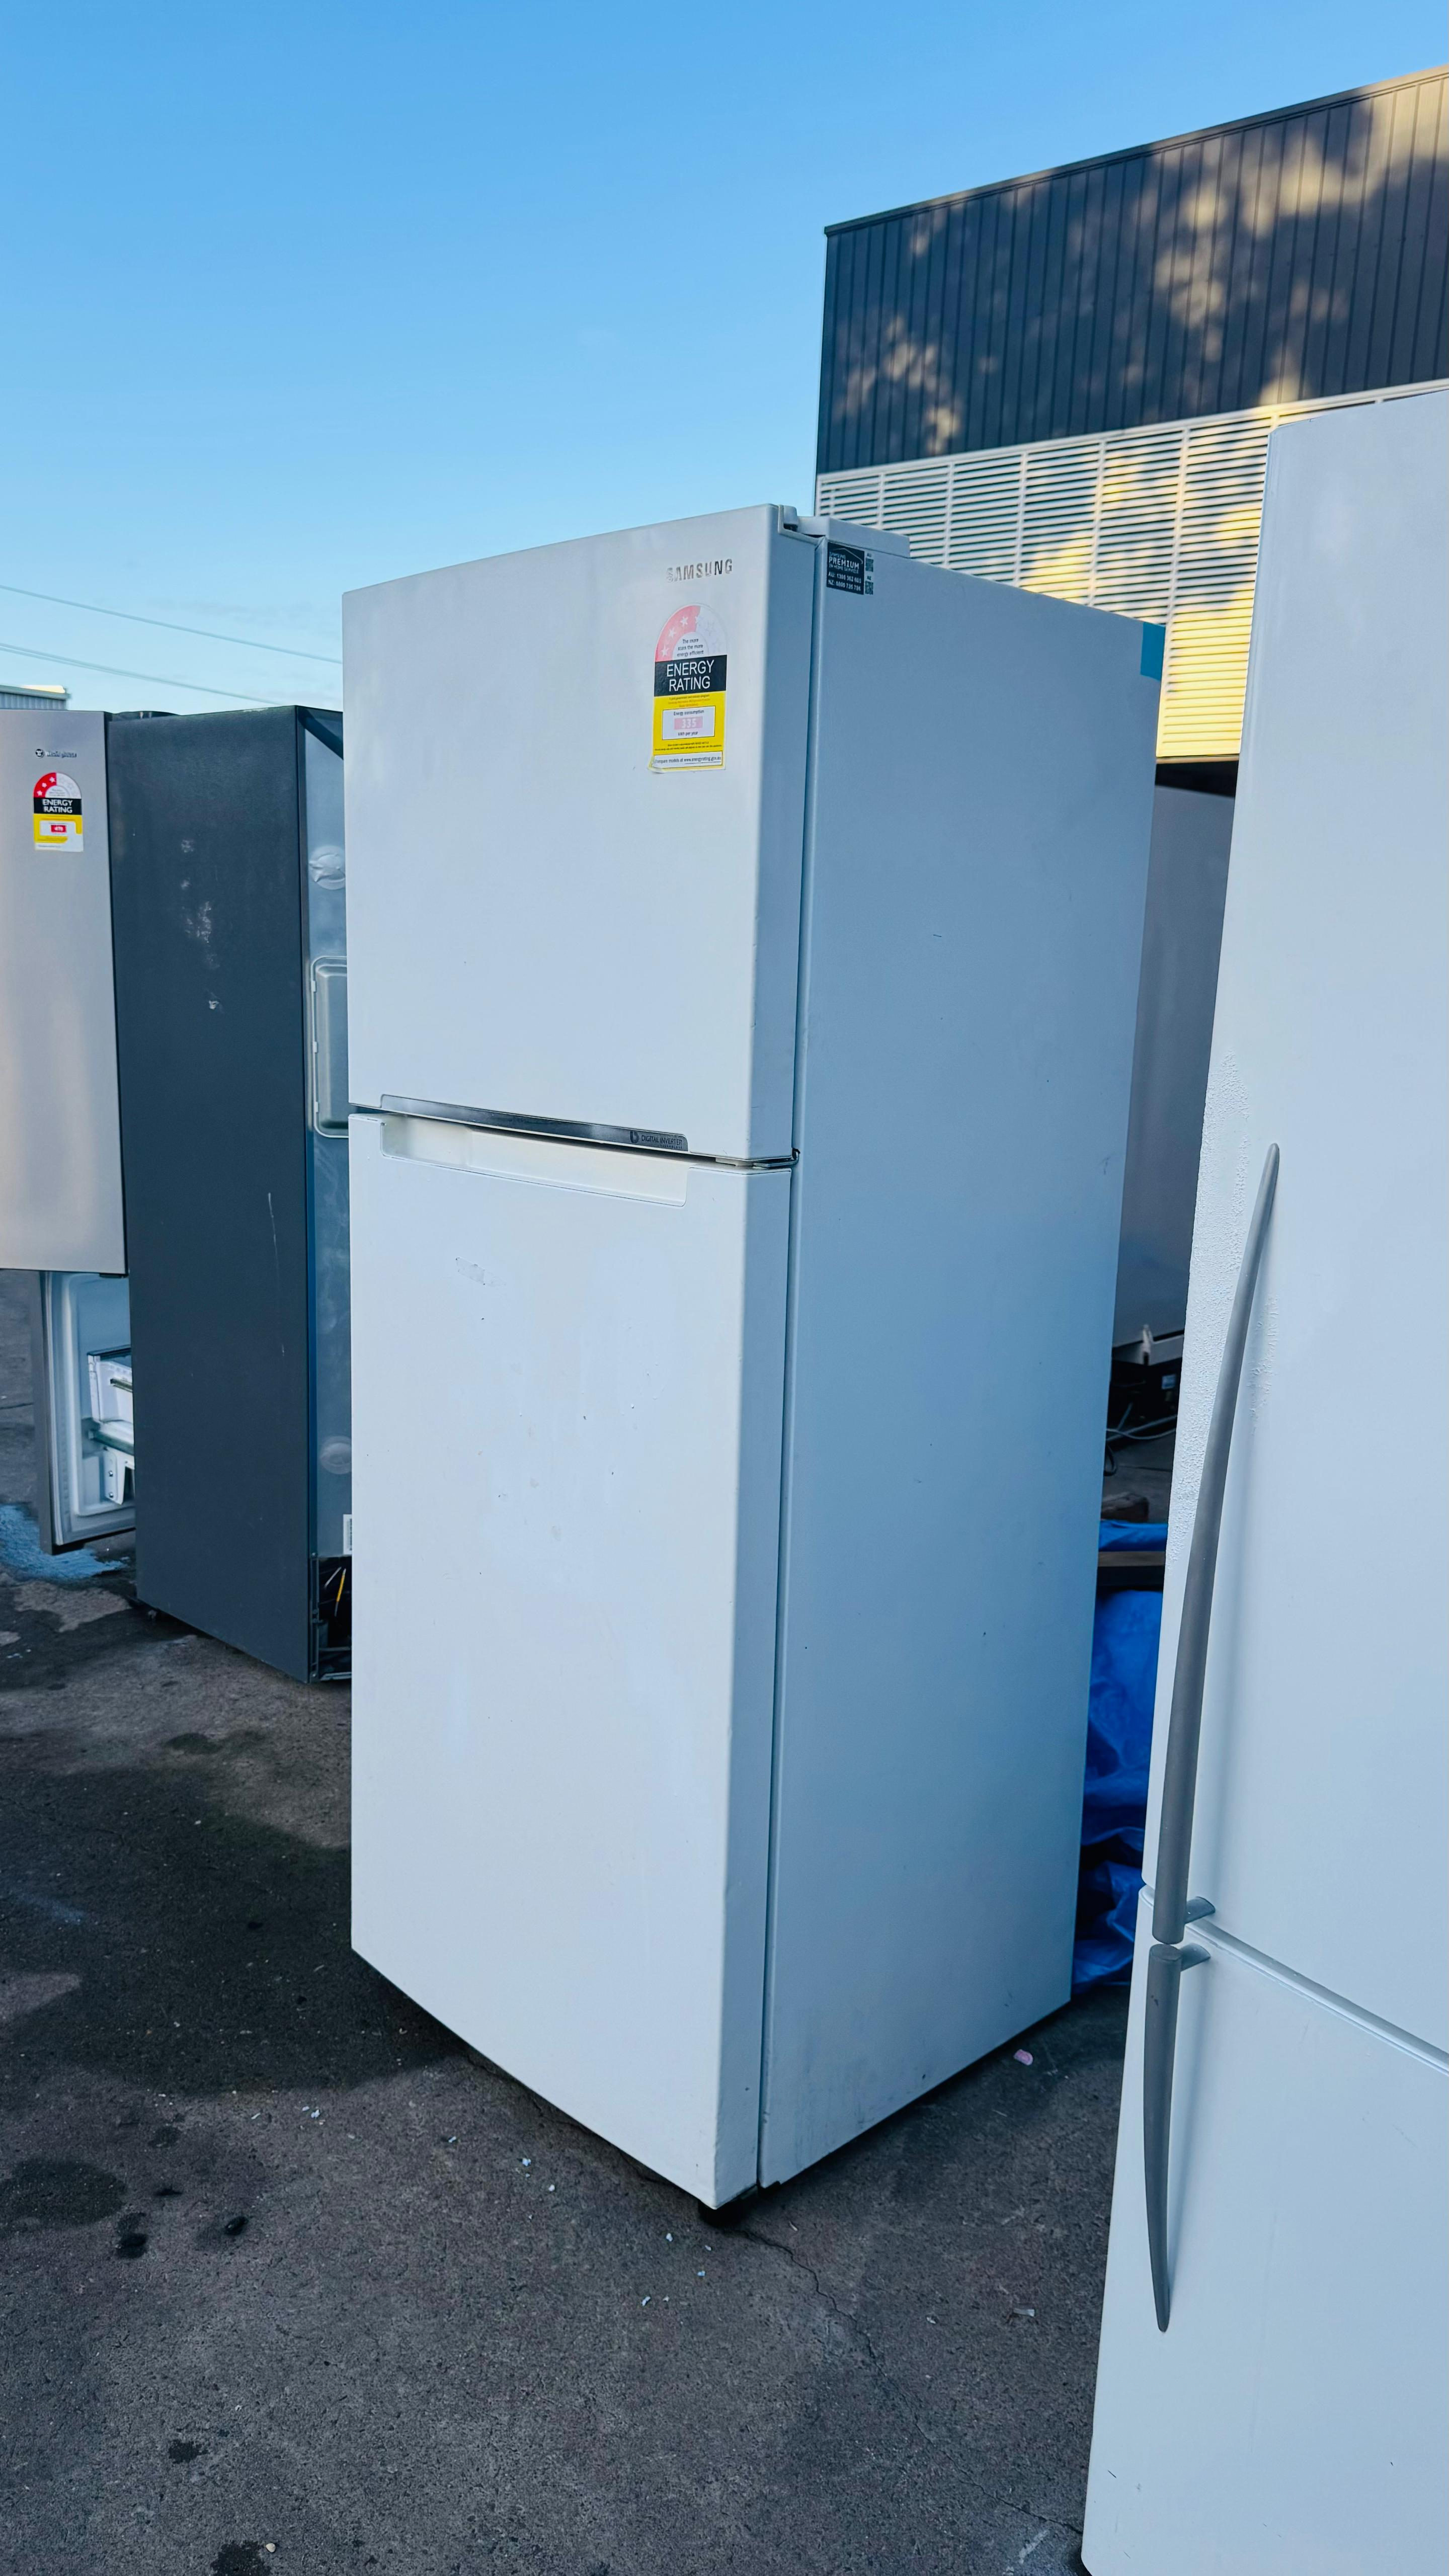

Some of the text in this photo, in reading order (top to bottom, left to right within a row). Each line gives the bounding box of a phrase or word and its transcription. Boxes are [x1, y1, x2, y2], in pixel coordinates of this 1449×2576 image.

[666, 558, 733, 583] SAMSUNG
[829, 556, 859, 570] PREMIUM
[666, 660, 714, 677] ENERGY
[669, 676, 710, 692] RATING
[681, 718, 697, 729] 335
[641, 1135, 682, 1145] DIGITAL INVERTER
